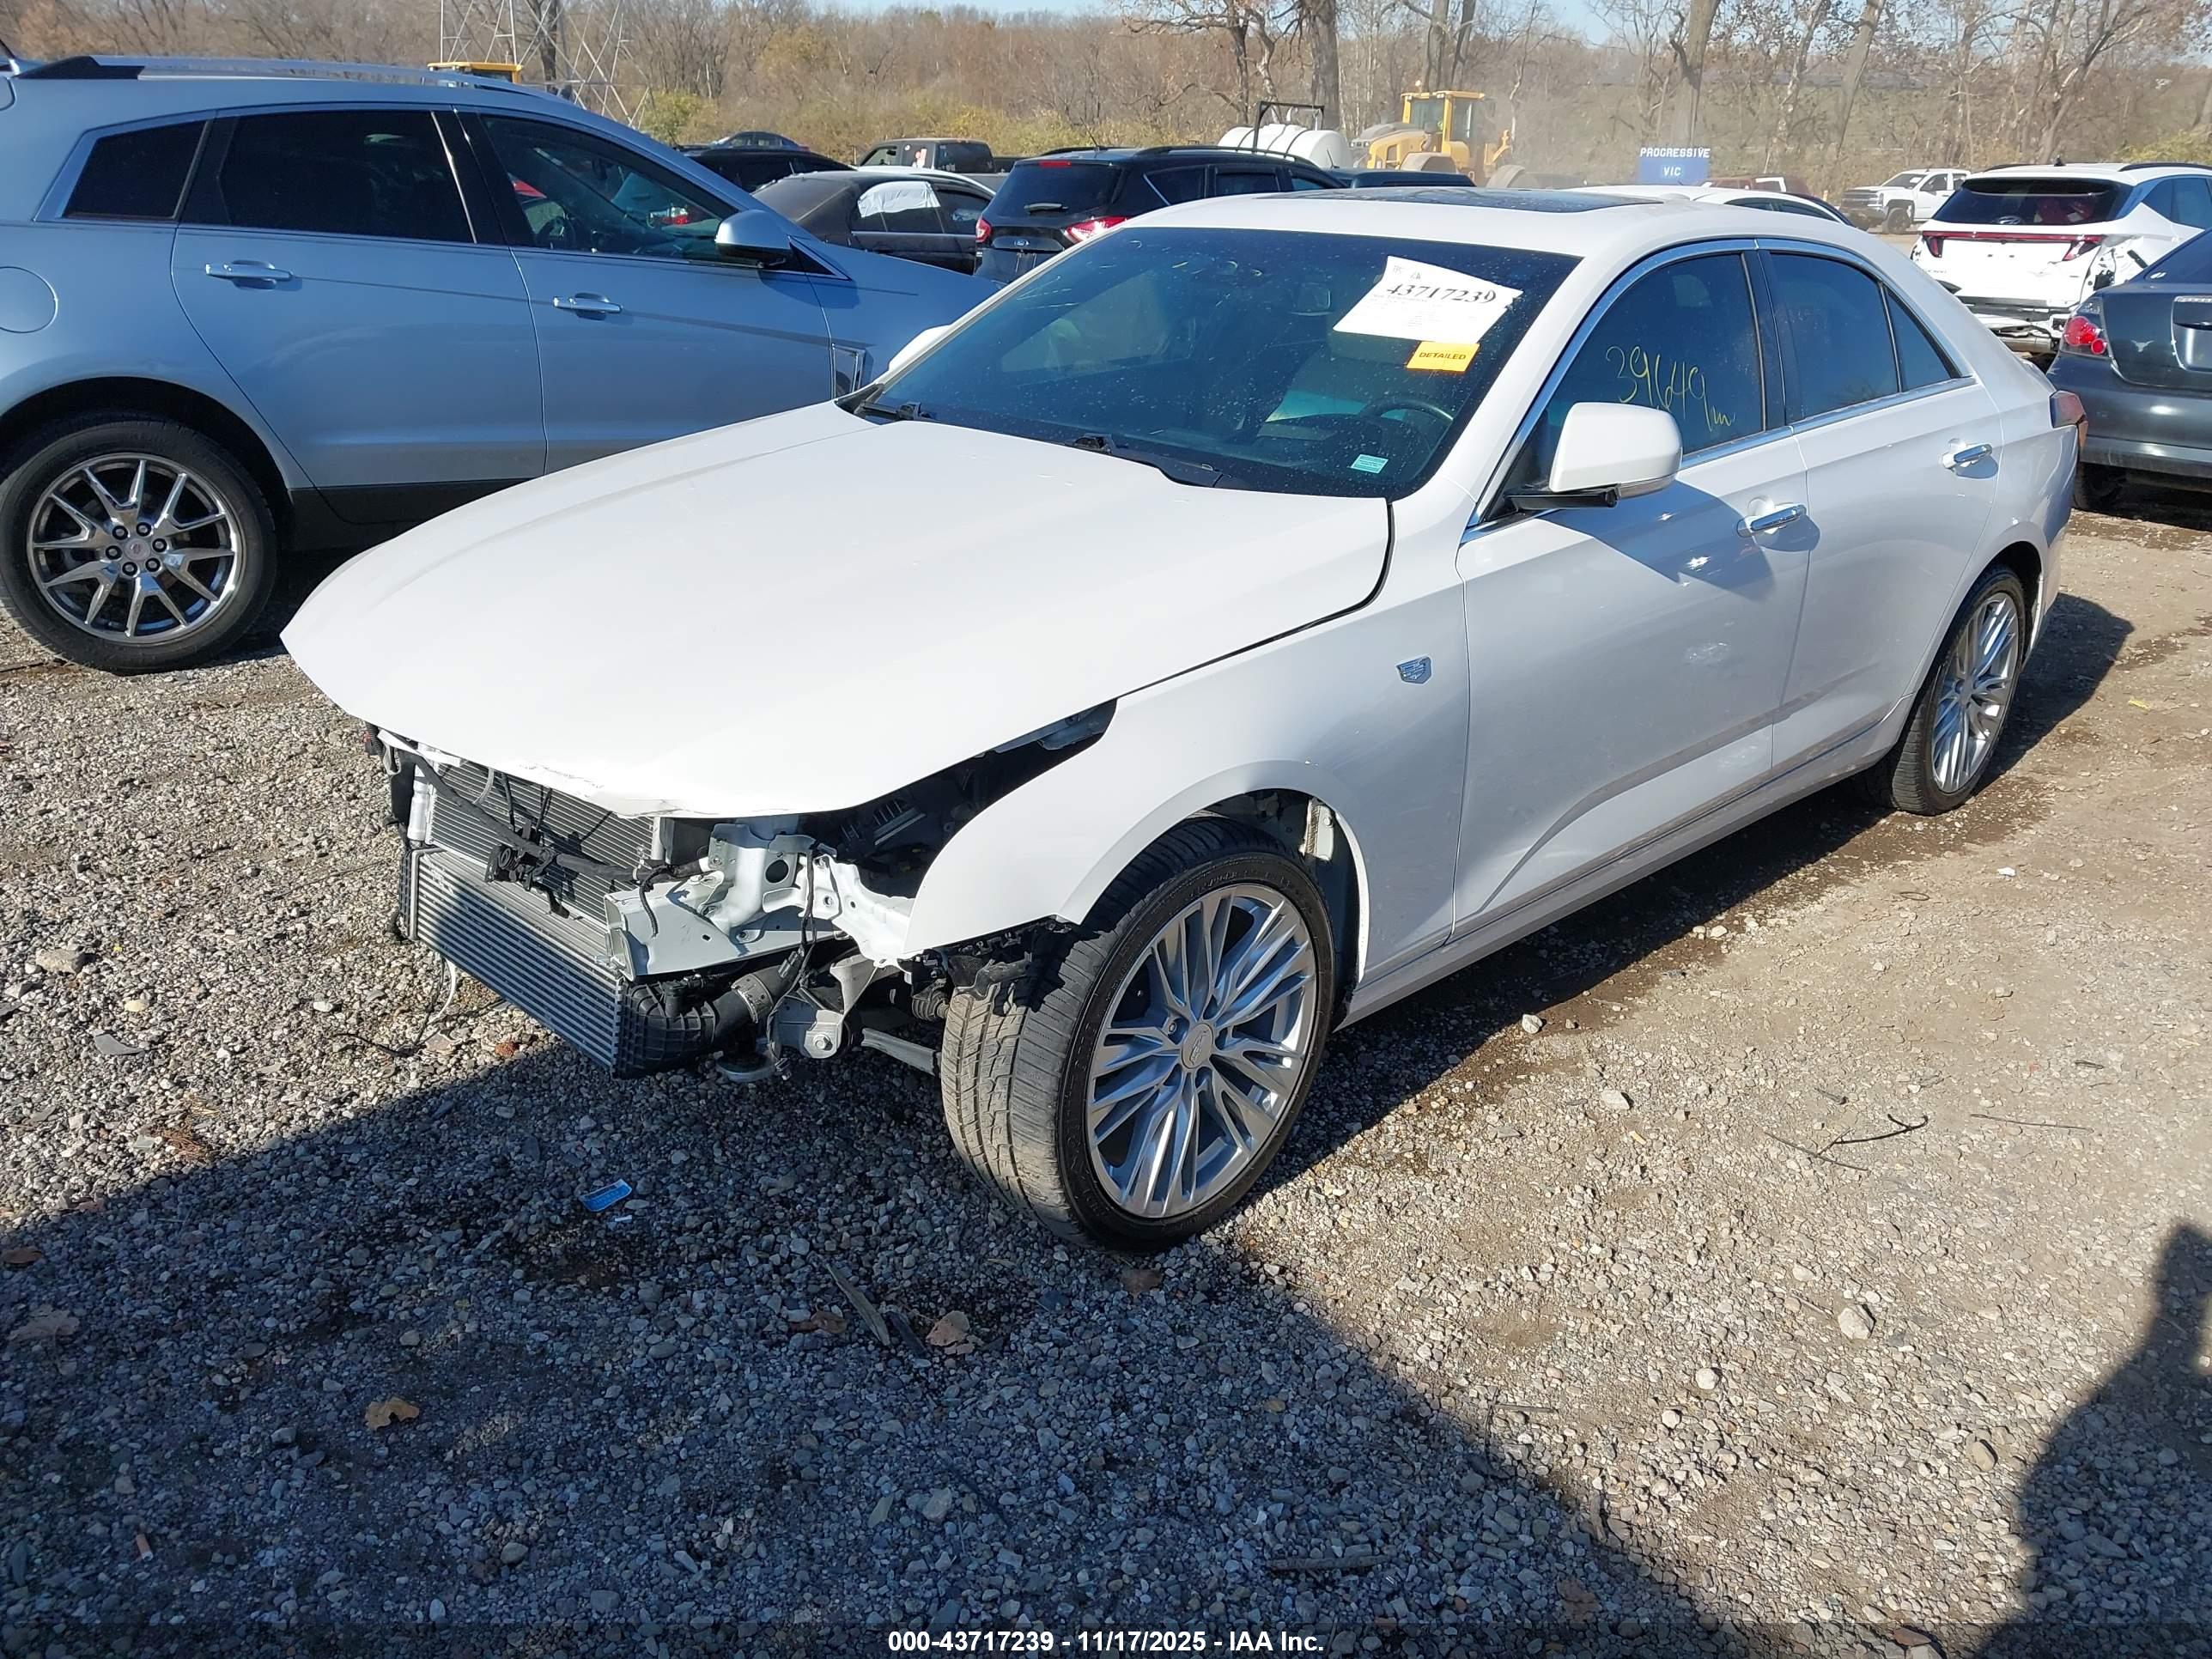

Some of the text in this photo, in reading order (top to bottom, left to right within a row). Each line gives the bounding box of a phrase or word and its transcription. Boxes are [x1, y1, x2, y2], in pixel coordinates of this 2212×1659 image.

[1640, 148, 1711, 158] PROGRESSIVE
[1663, 167, 1681, 176] VIC
[1388, 283, 1497, 303] 43717239
[1419, 351, 1467, 361] DETAILED
